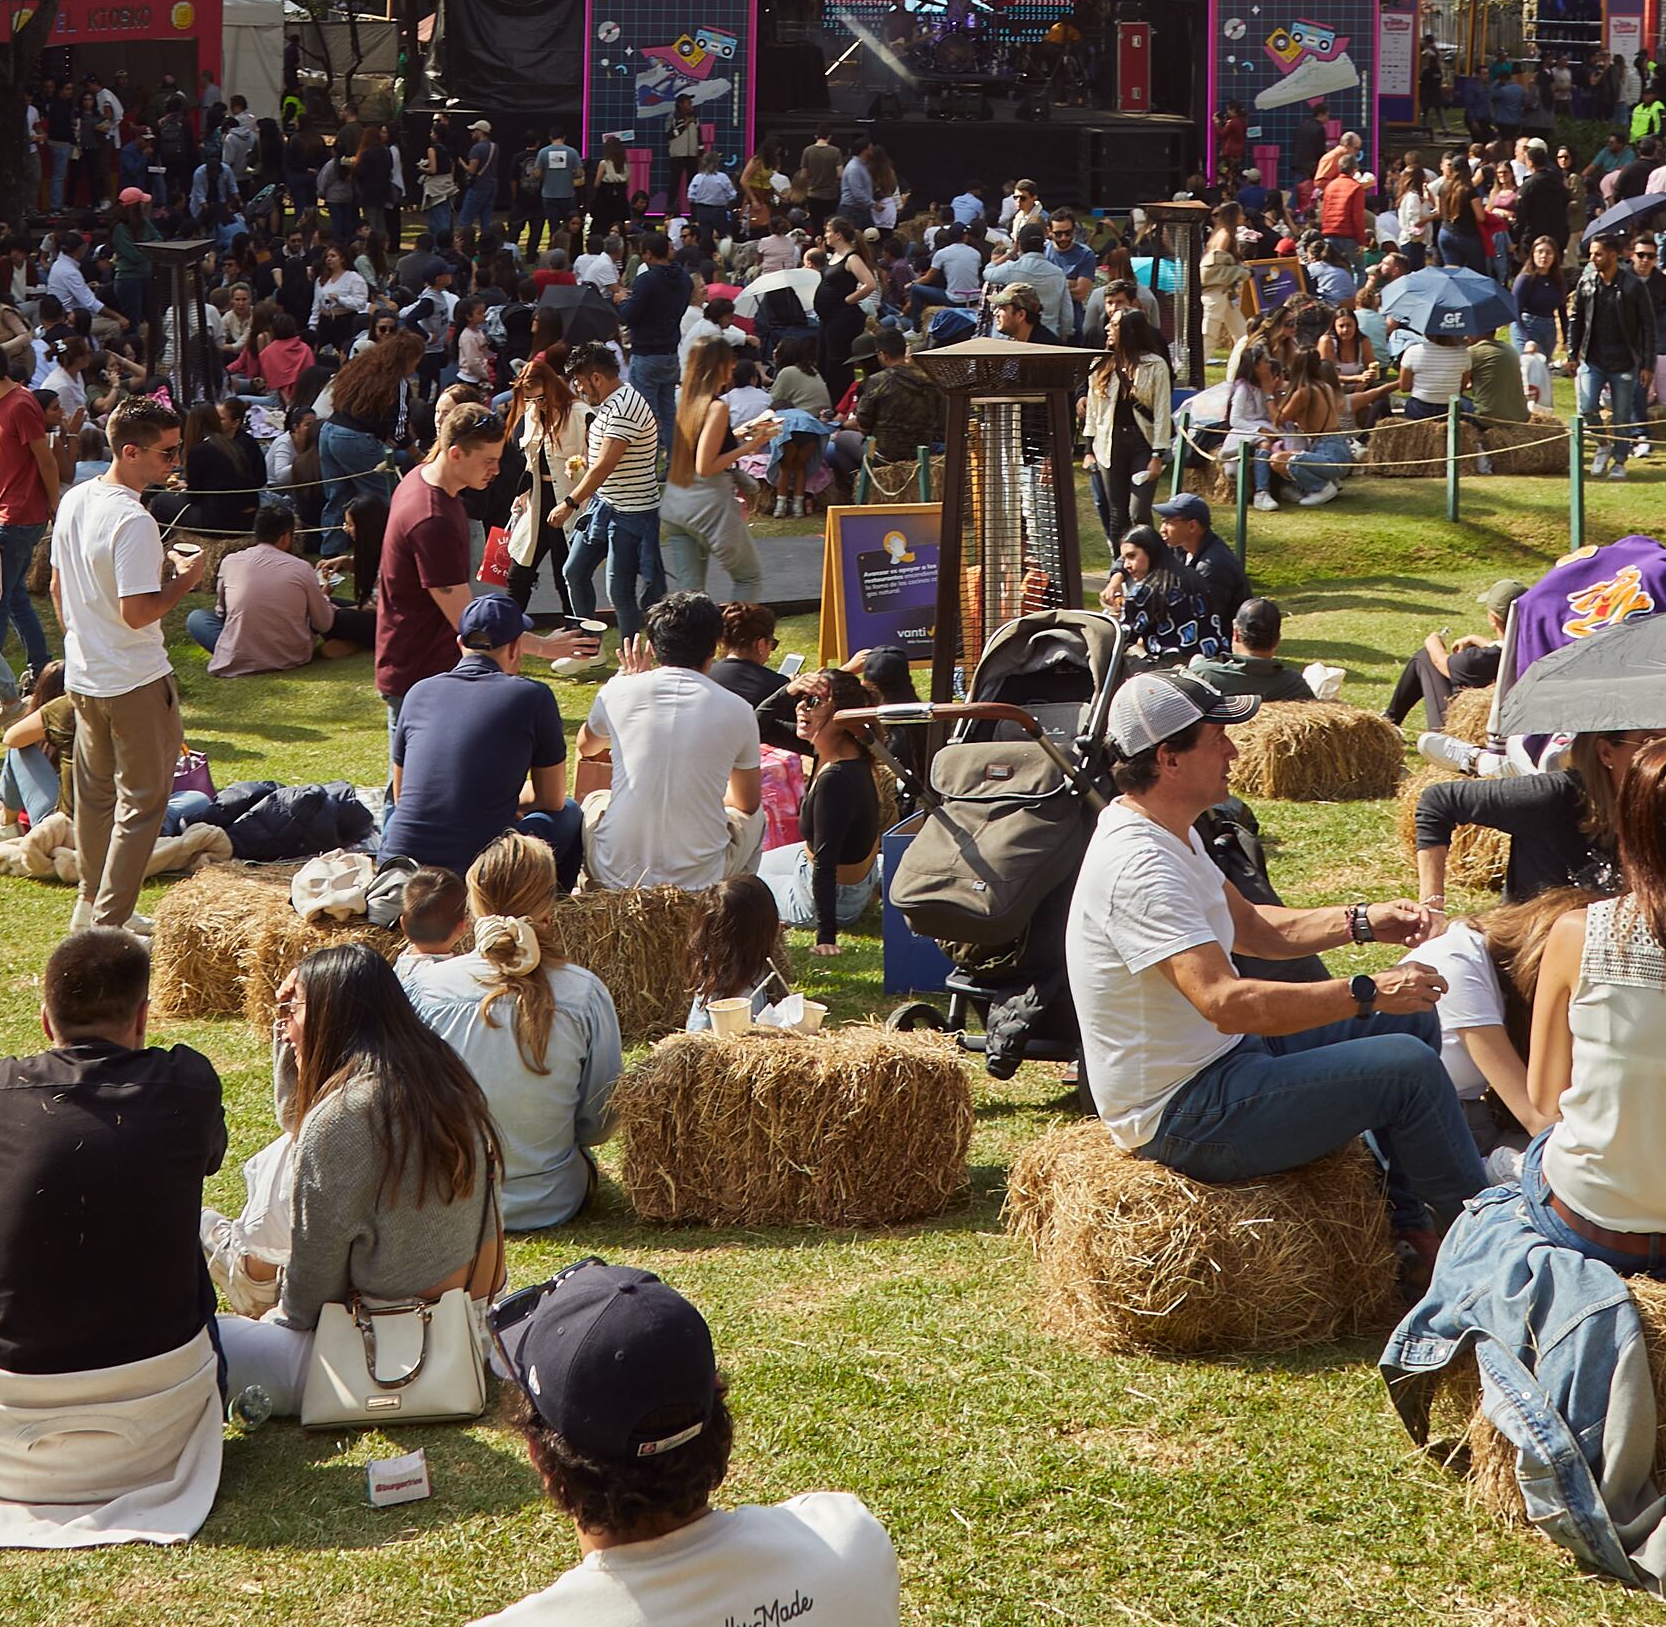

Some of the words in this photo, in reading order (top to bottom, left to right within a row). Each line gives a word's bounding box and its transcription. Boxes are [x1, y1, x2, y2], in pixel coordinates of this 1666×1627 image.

[56, 12, 78, 33] EL
[87, 6, 153, 32] KIOSKO
[490, 564, 502, 575] for
[897, 626, 927, 639] vanti
[754, 1589, 814, 1627] Made
